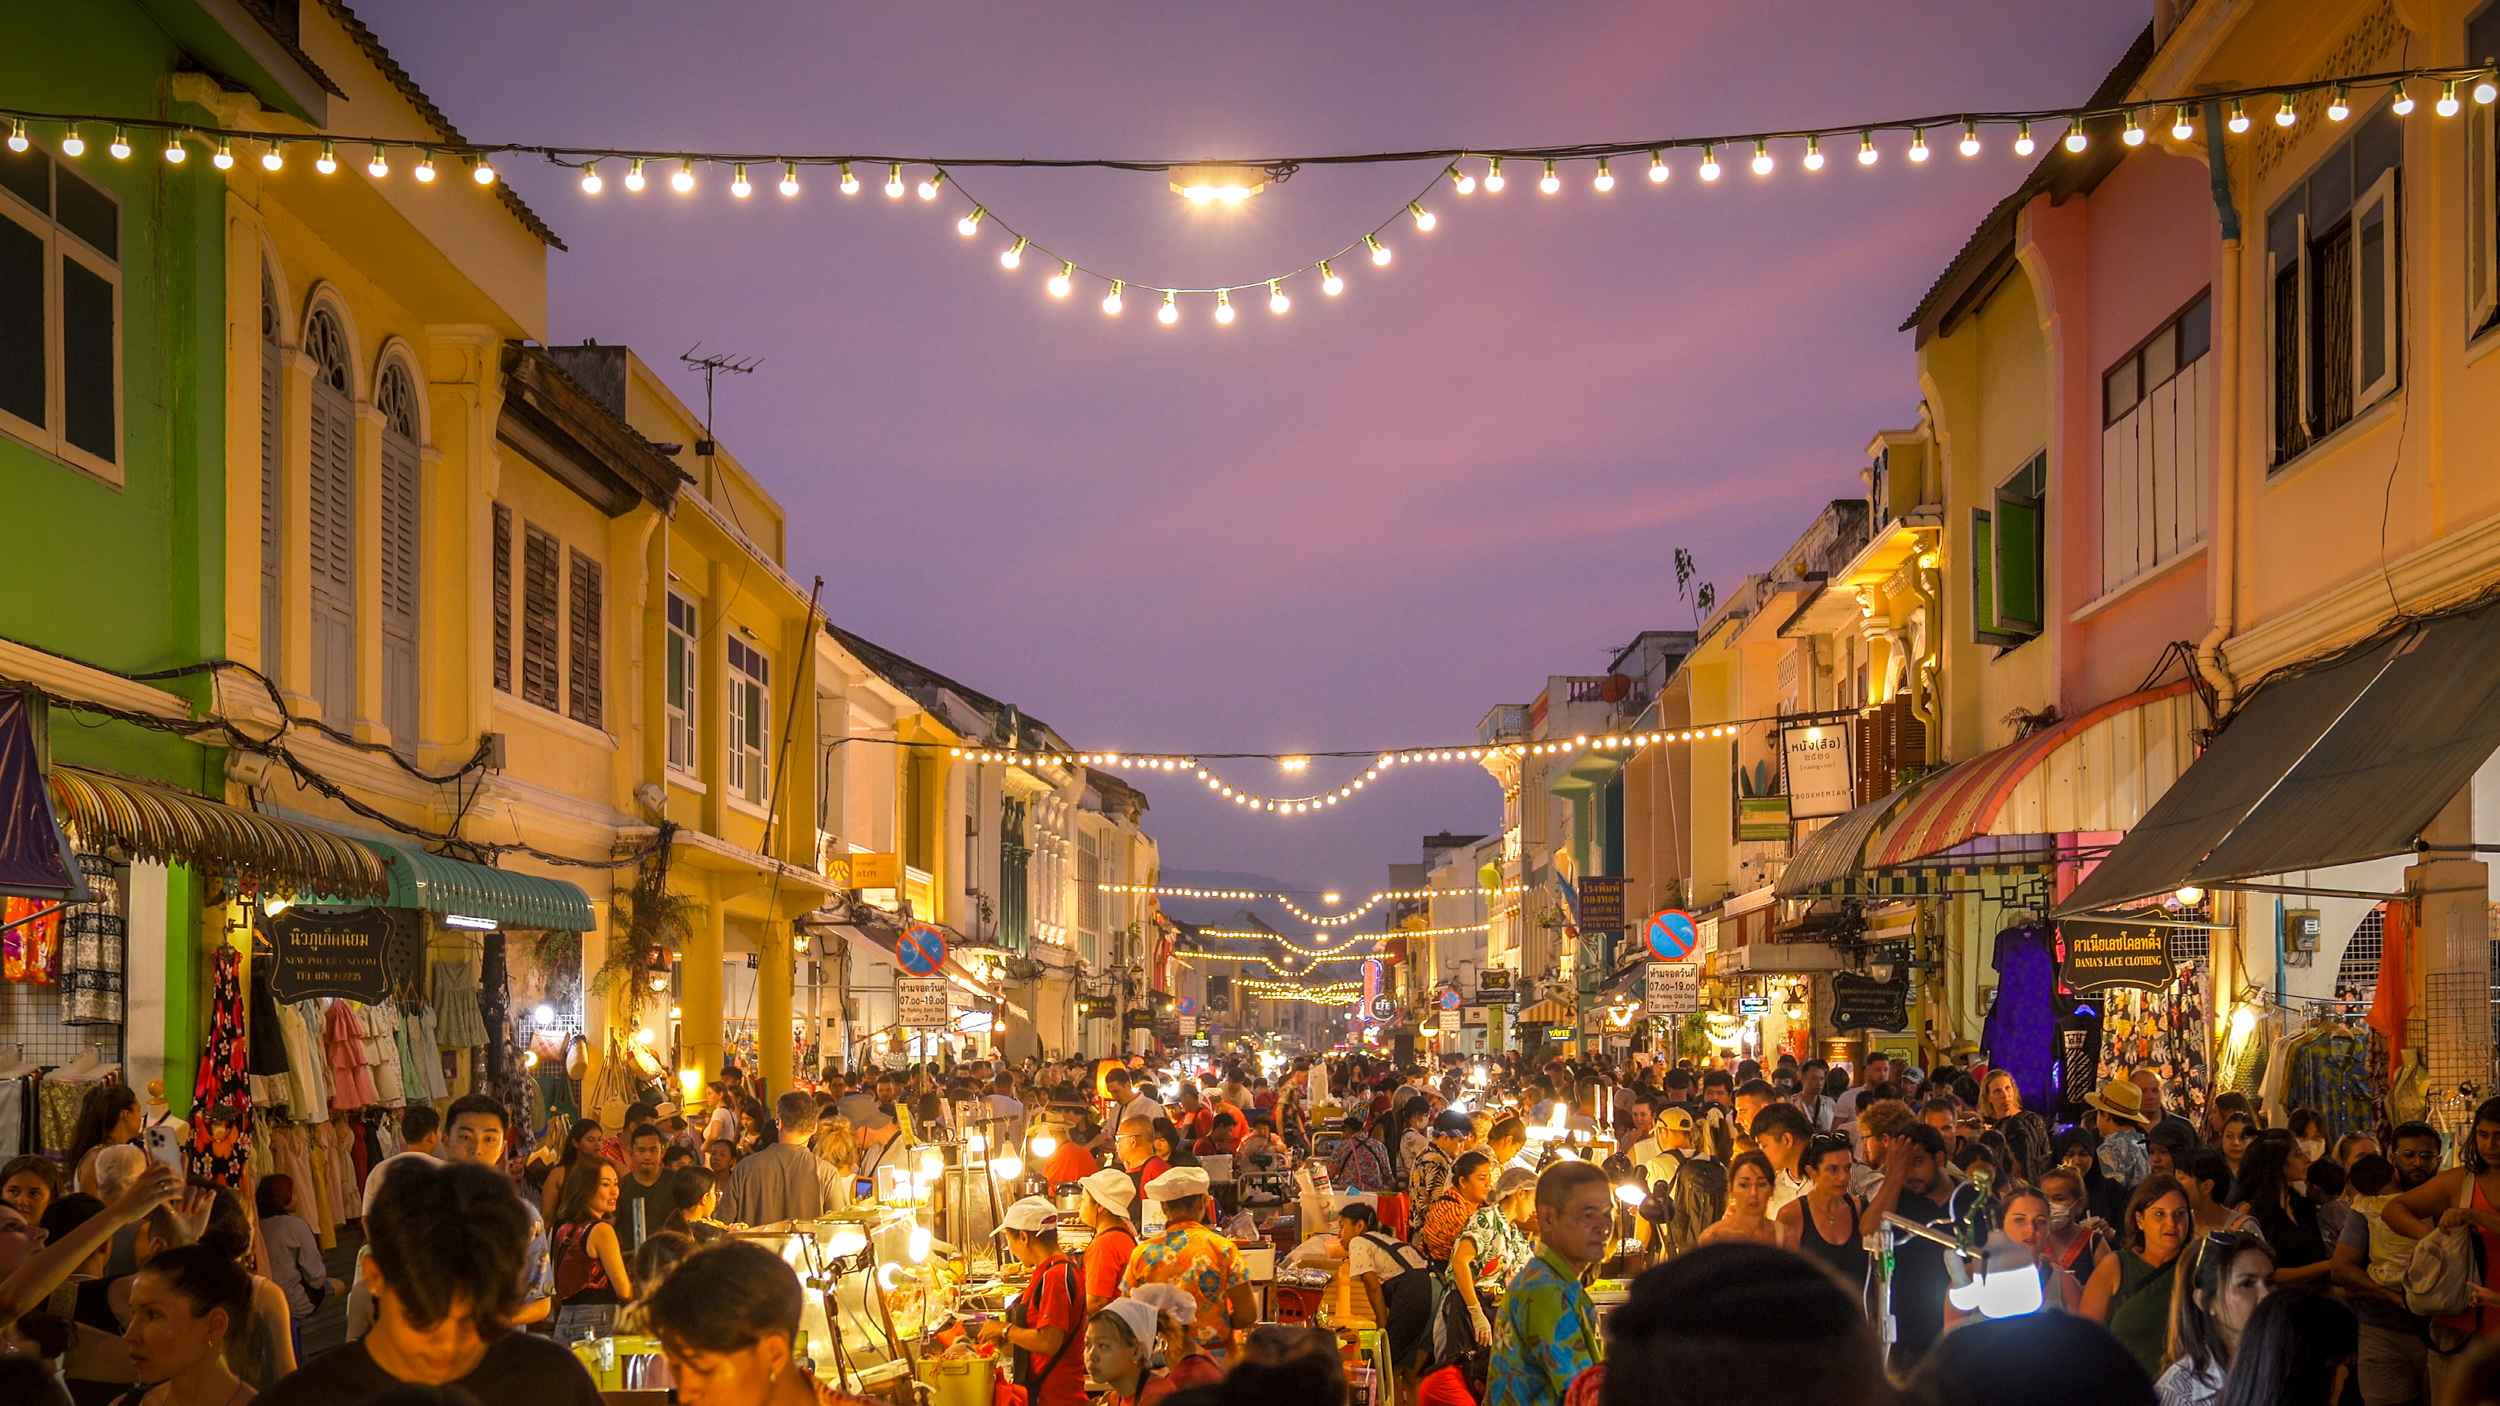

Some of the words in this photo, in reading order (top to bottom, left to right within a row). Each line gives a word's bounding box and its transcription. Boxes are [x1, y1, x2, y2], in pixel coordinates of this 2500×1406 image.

[1792, 737, 1841, 752] หนัง(สือ)
[2075, 957, 2103, 968] DANIA'S
[2104, 956, 2124, 967] LACE
[2125, 955, 2162, 967] CLOTHING
